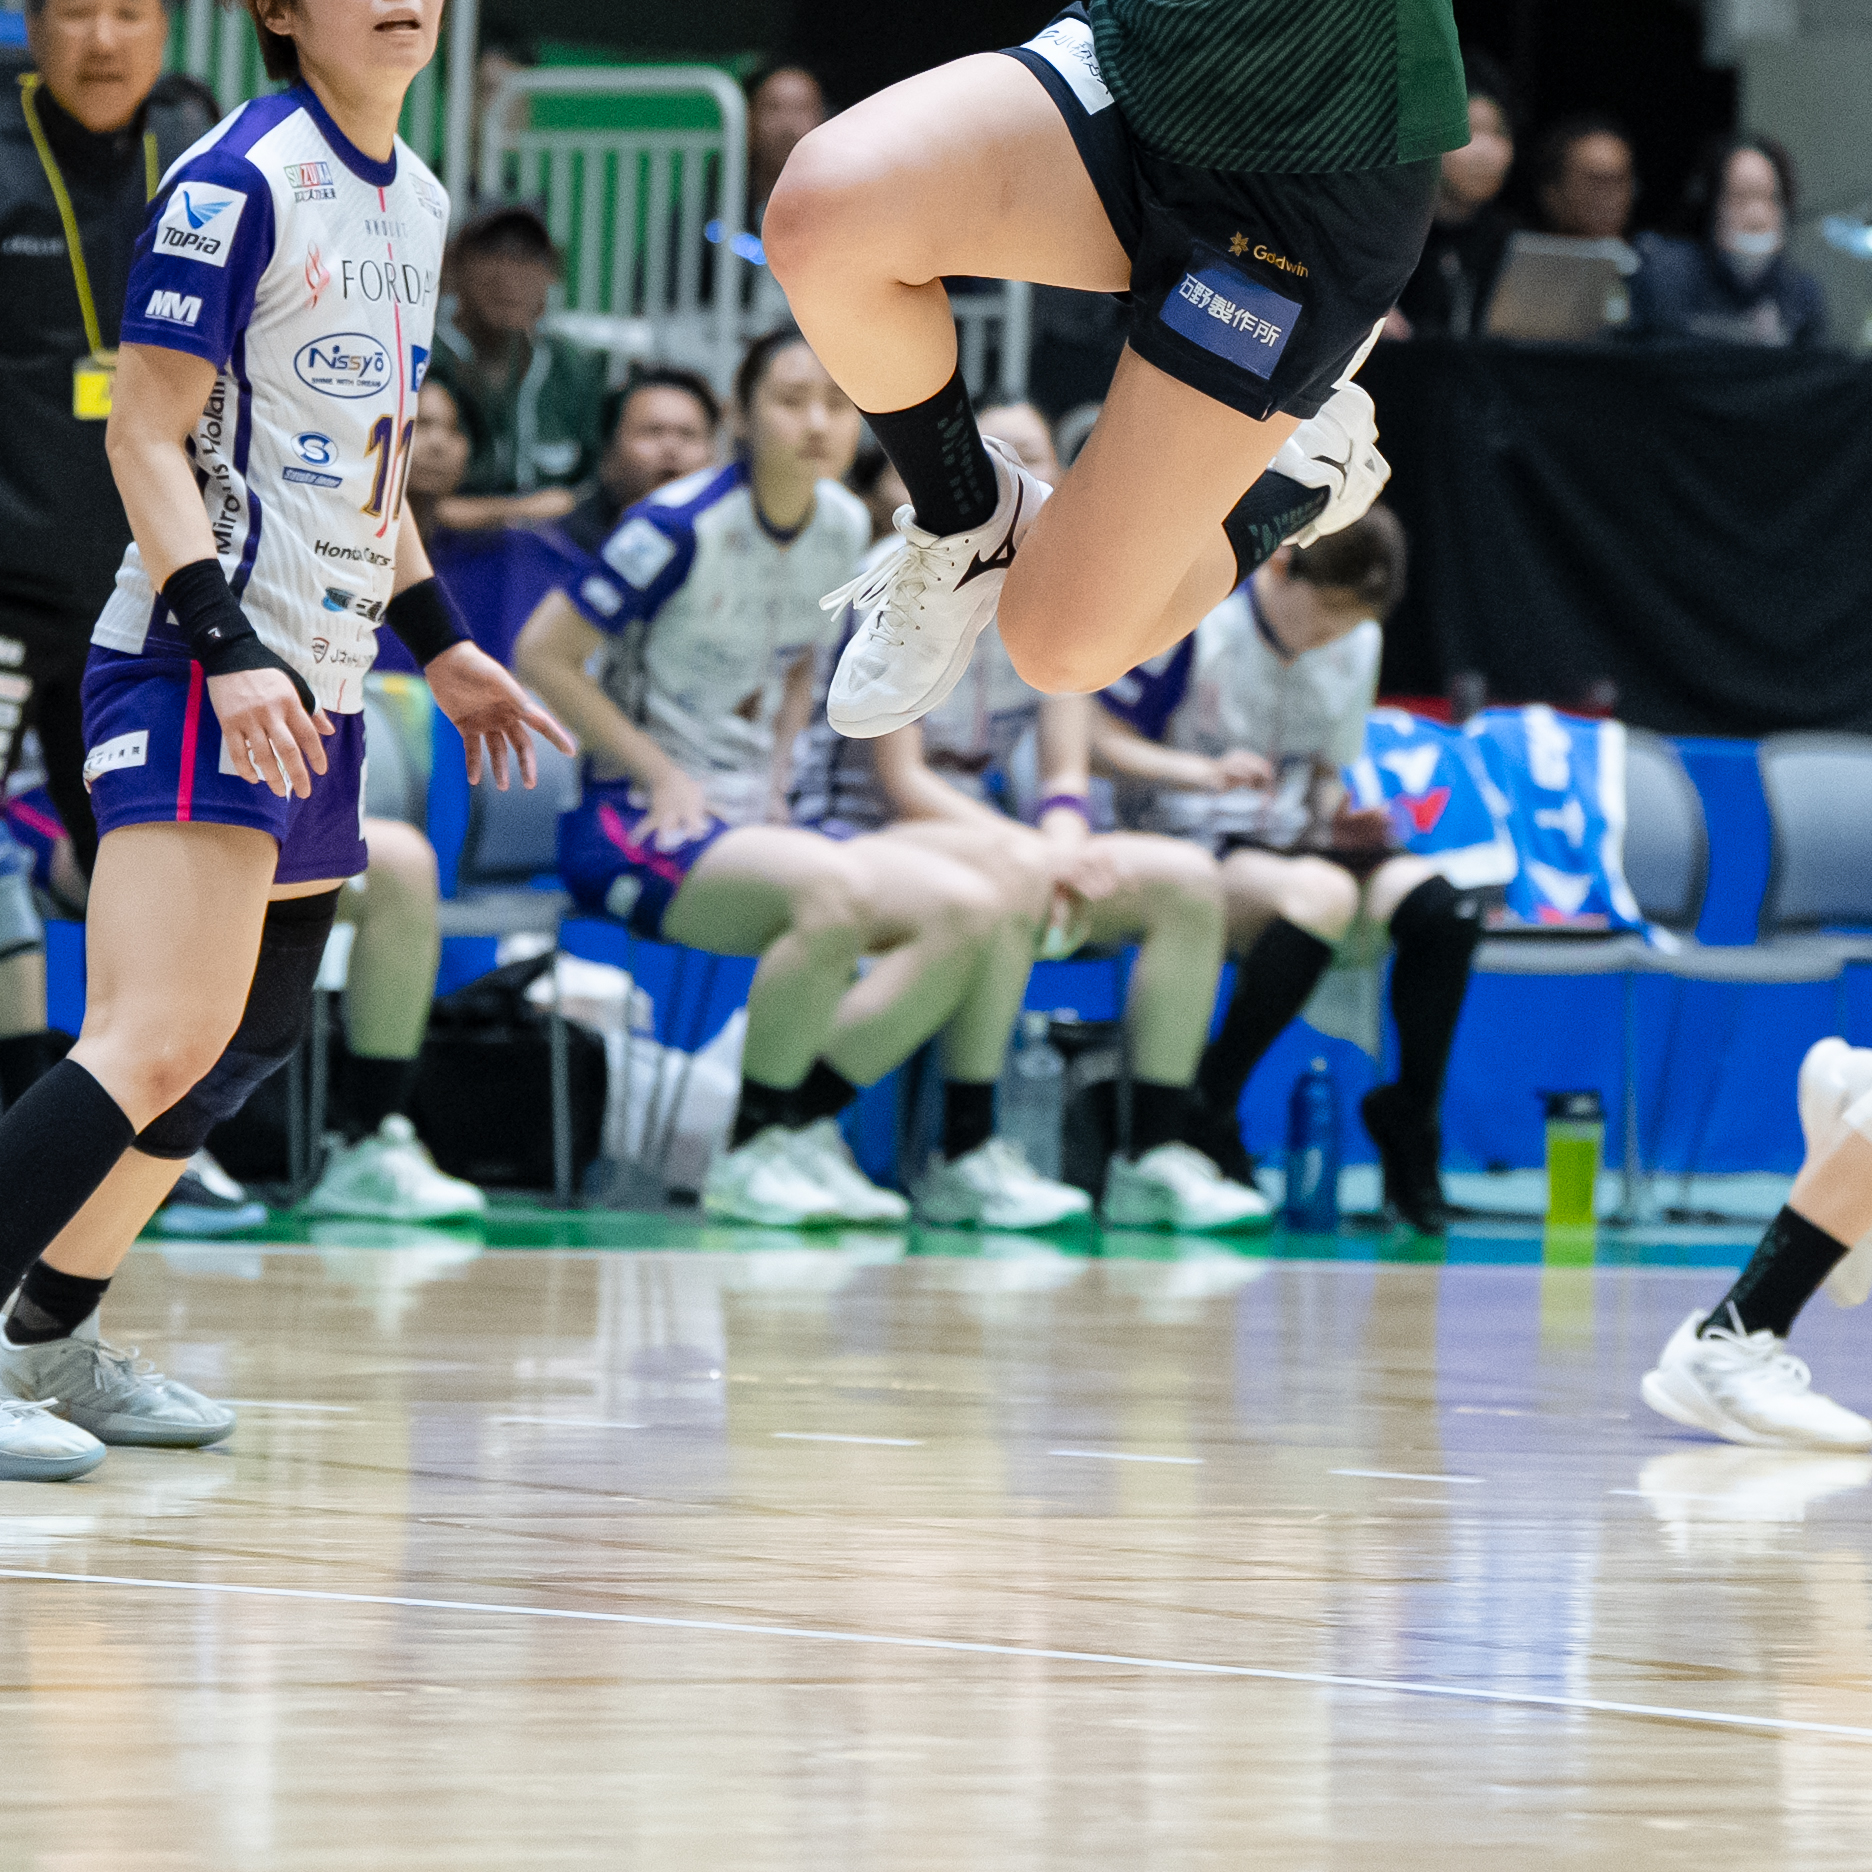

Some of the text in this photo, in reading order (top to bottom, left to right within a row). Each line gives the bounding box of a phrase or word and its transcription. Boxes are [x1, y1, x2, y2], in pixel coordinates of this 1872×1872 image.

[1253, 245, 1308, 277] Godwin
[1178, 273, 1282, 347] 石野製作所
[360, 414, 415, 521] 11
